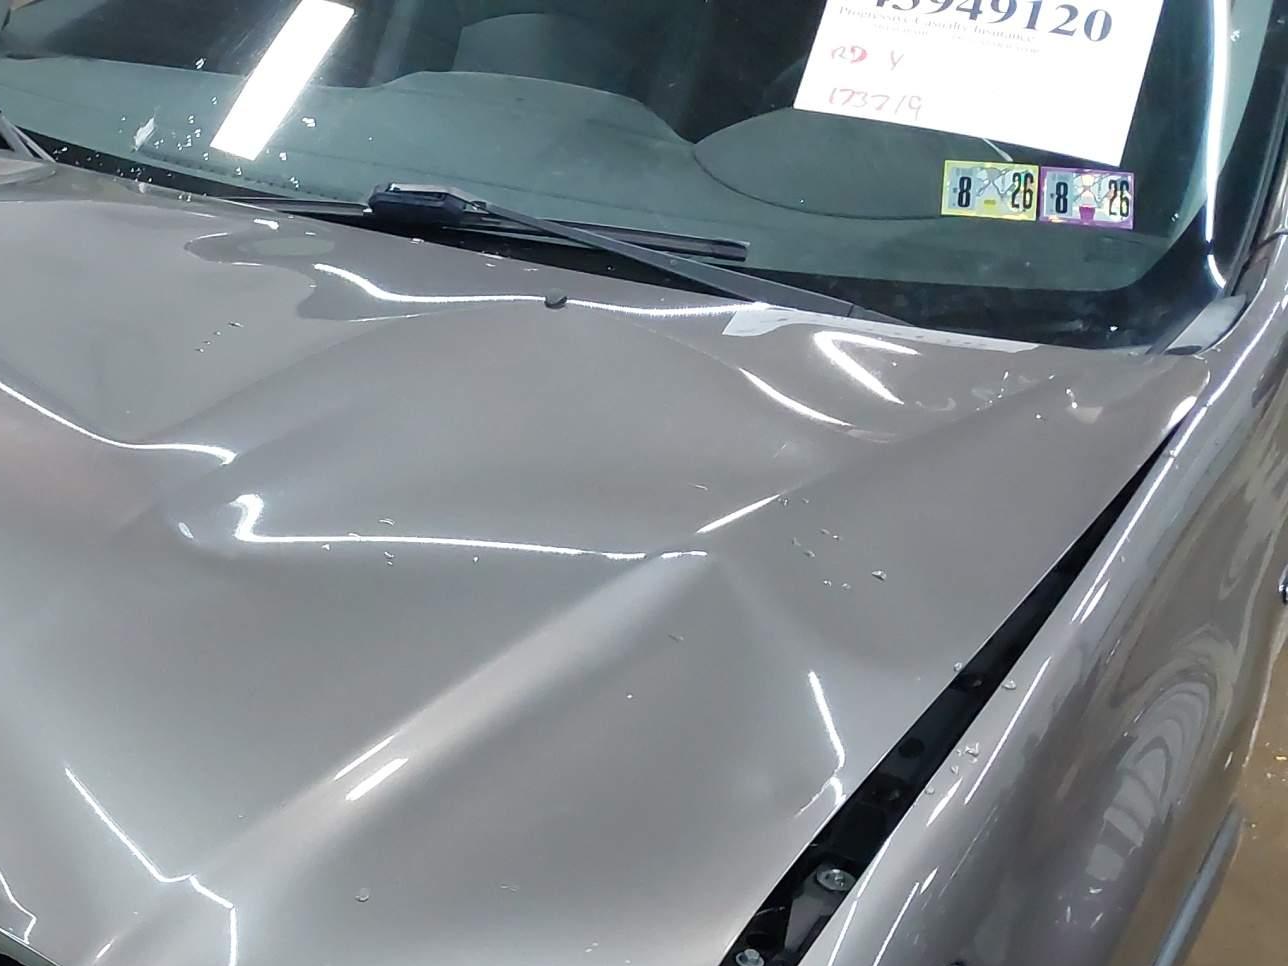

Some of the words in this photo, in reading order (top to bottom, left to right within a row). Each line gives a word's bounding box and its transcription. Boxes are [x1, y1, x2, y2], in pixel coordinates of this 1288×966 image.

[957, 176, 972, 208] 8
[1011, 172, 1034, 210] 26
[1055, 182, 1069, 214] 8
[1108, 179, 1130, 218] 26
